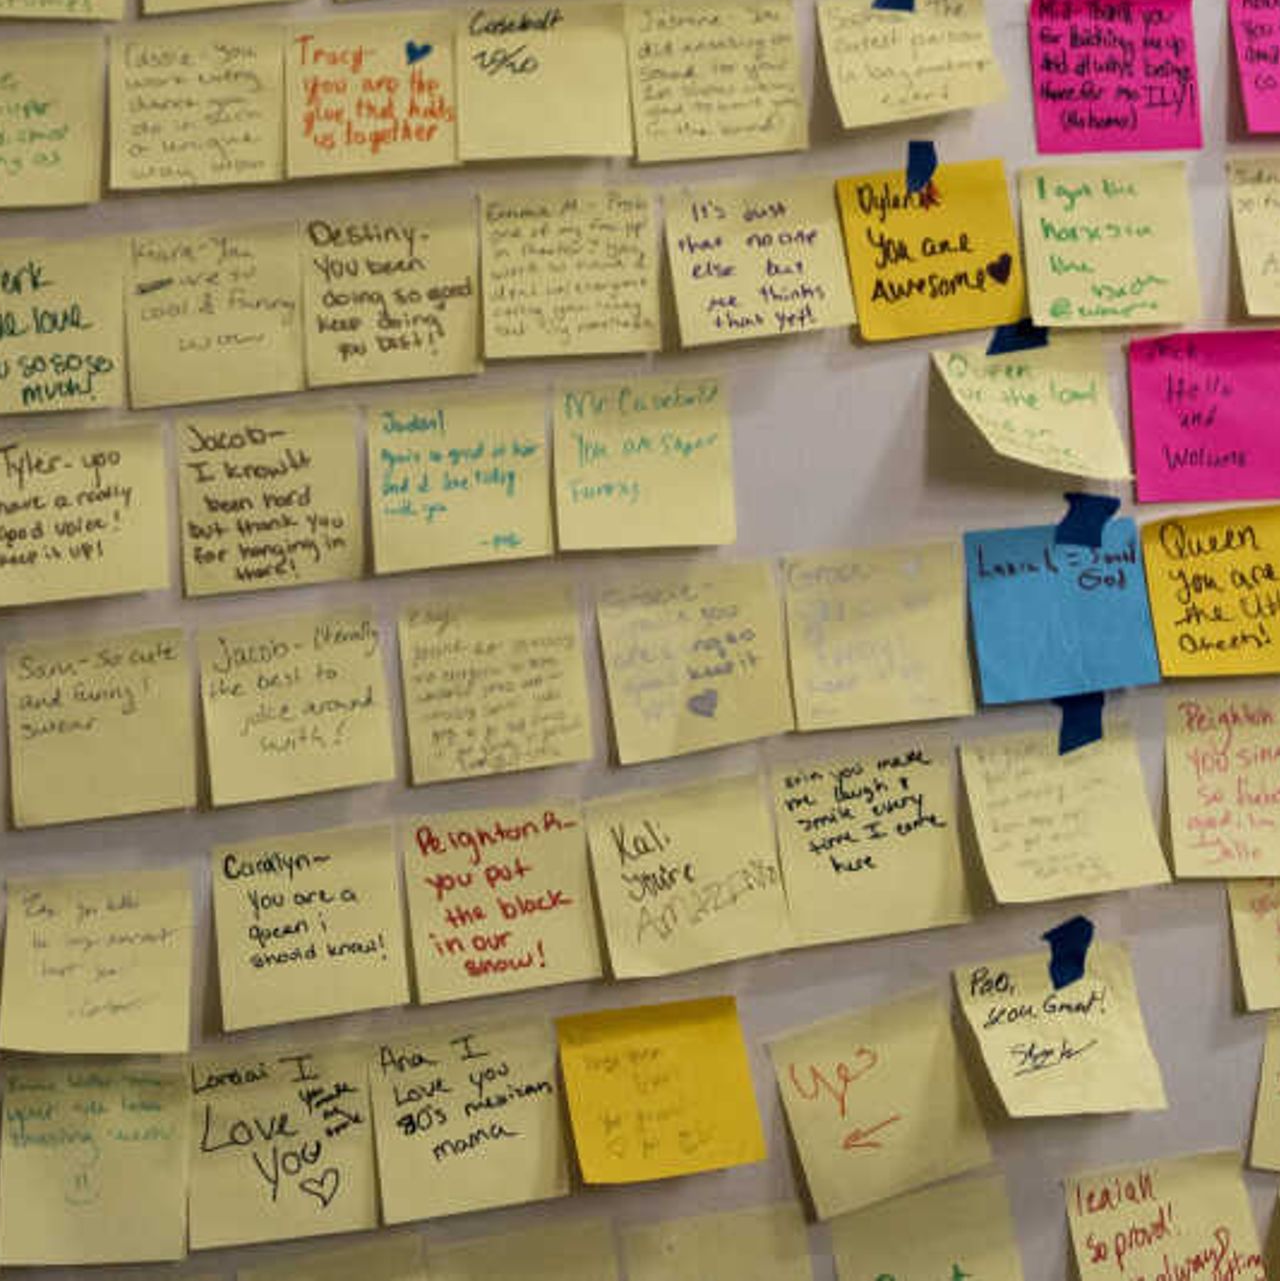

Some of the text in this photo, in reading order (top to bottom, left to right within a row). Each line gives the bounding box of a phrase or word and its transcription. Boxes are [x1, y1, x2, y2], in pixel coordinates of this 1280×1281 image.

[362, 75, 399, 94] are
[345, 120, 438, 155] together
[1158, 524, 1261, 555] Queen
[200, 1101, 298, 1153] Love
